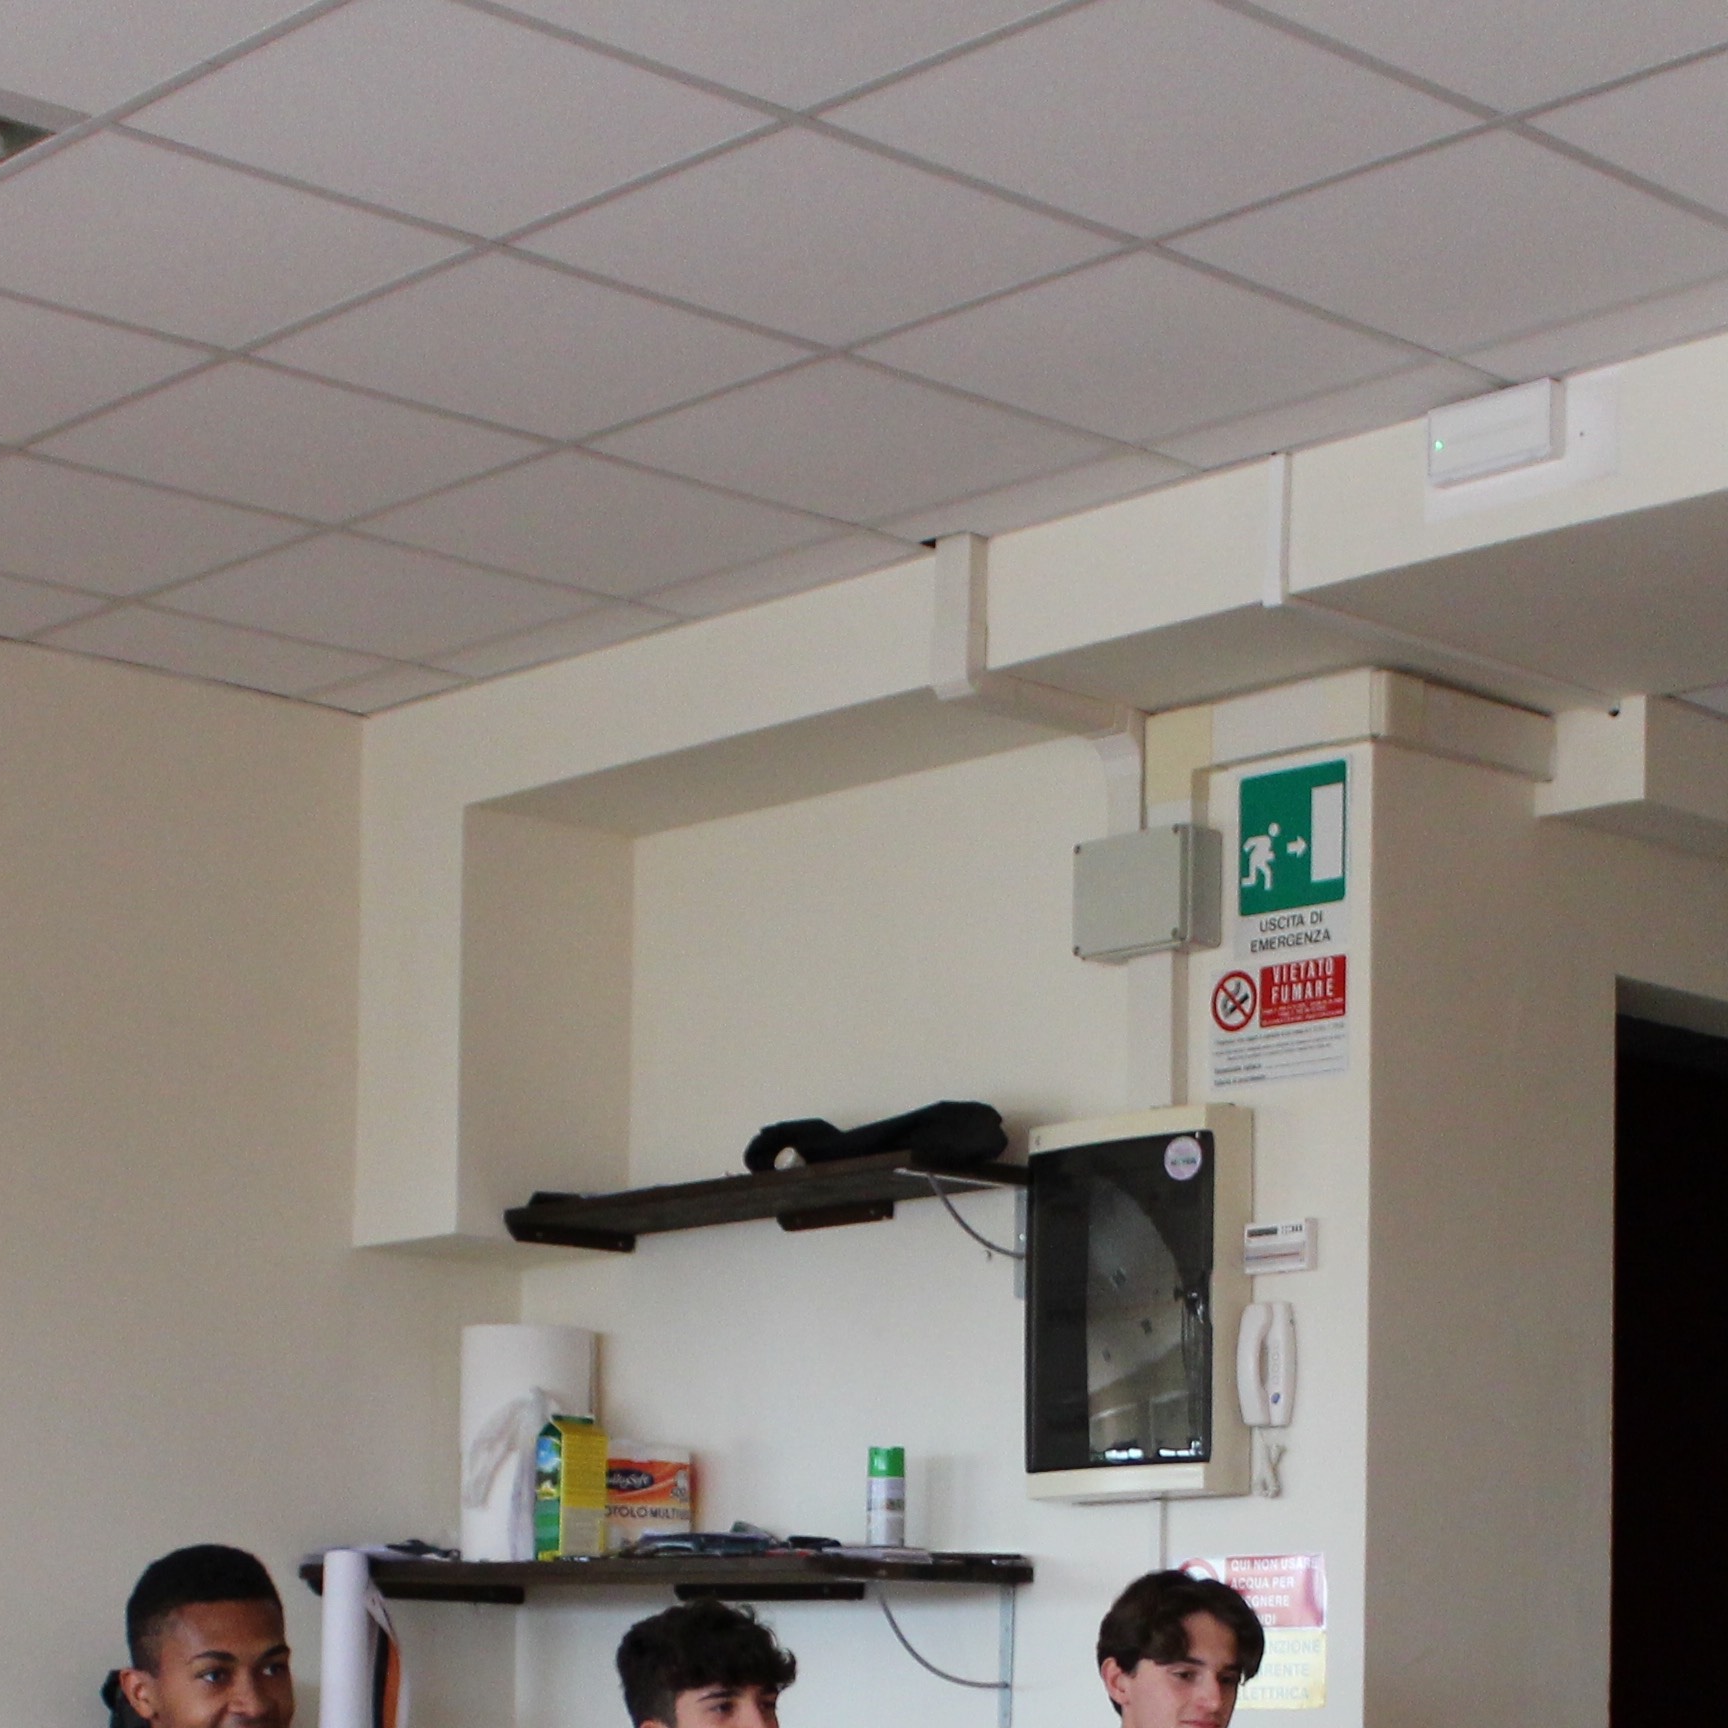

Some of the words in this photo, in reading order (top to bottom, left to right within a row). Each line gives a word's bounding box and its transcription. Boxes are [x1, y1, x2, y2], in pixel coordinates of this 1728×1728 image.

[1259, 913, 1305, 932] USCITA
[1309, 910, 1324, 925] DI
[1250, 929, 1331, 953] EMERGENZA
[1272, 956, 1335, 984] VIETATO
[1271, 978, 1334, 1004] FUMARE
[1230, 1559, 1250, 1572] QUI
[1253, 1558, 1279, 1571] NON
[1229, 1576, 1270, 1589] ACQUA
[1273, 1575, 1295, 1589] PER
